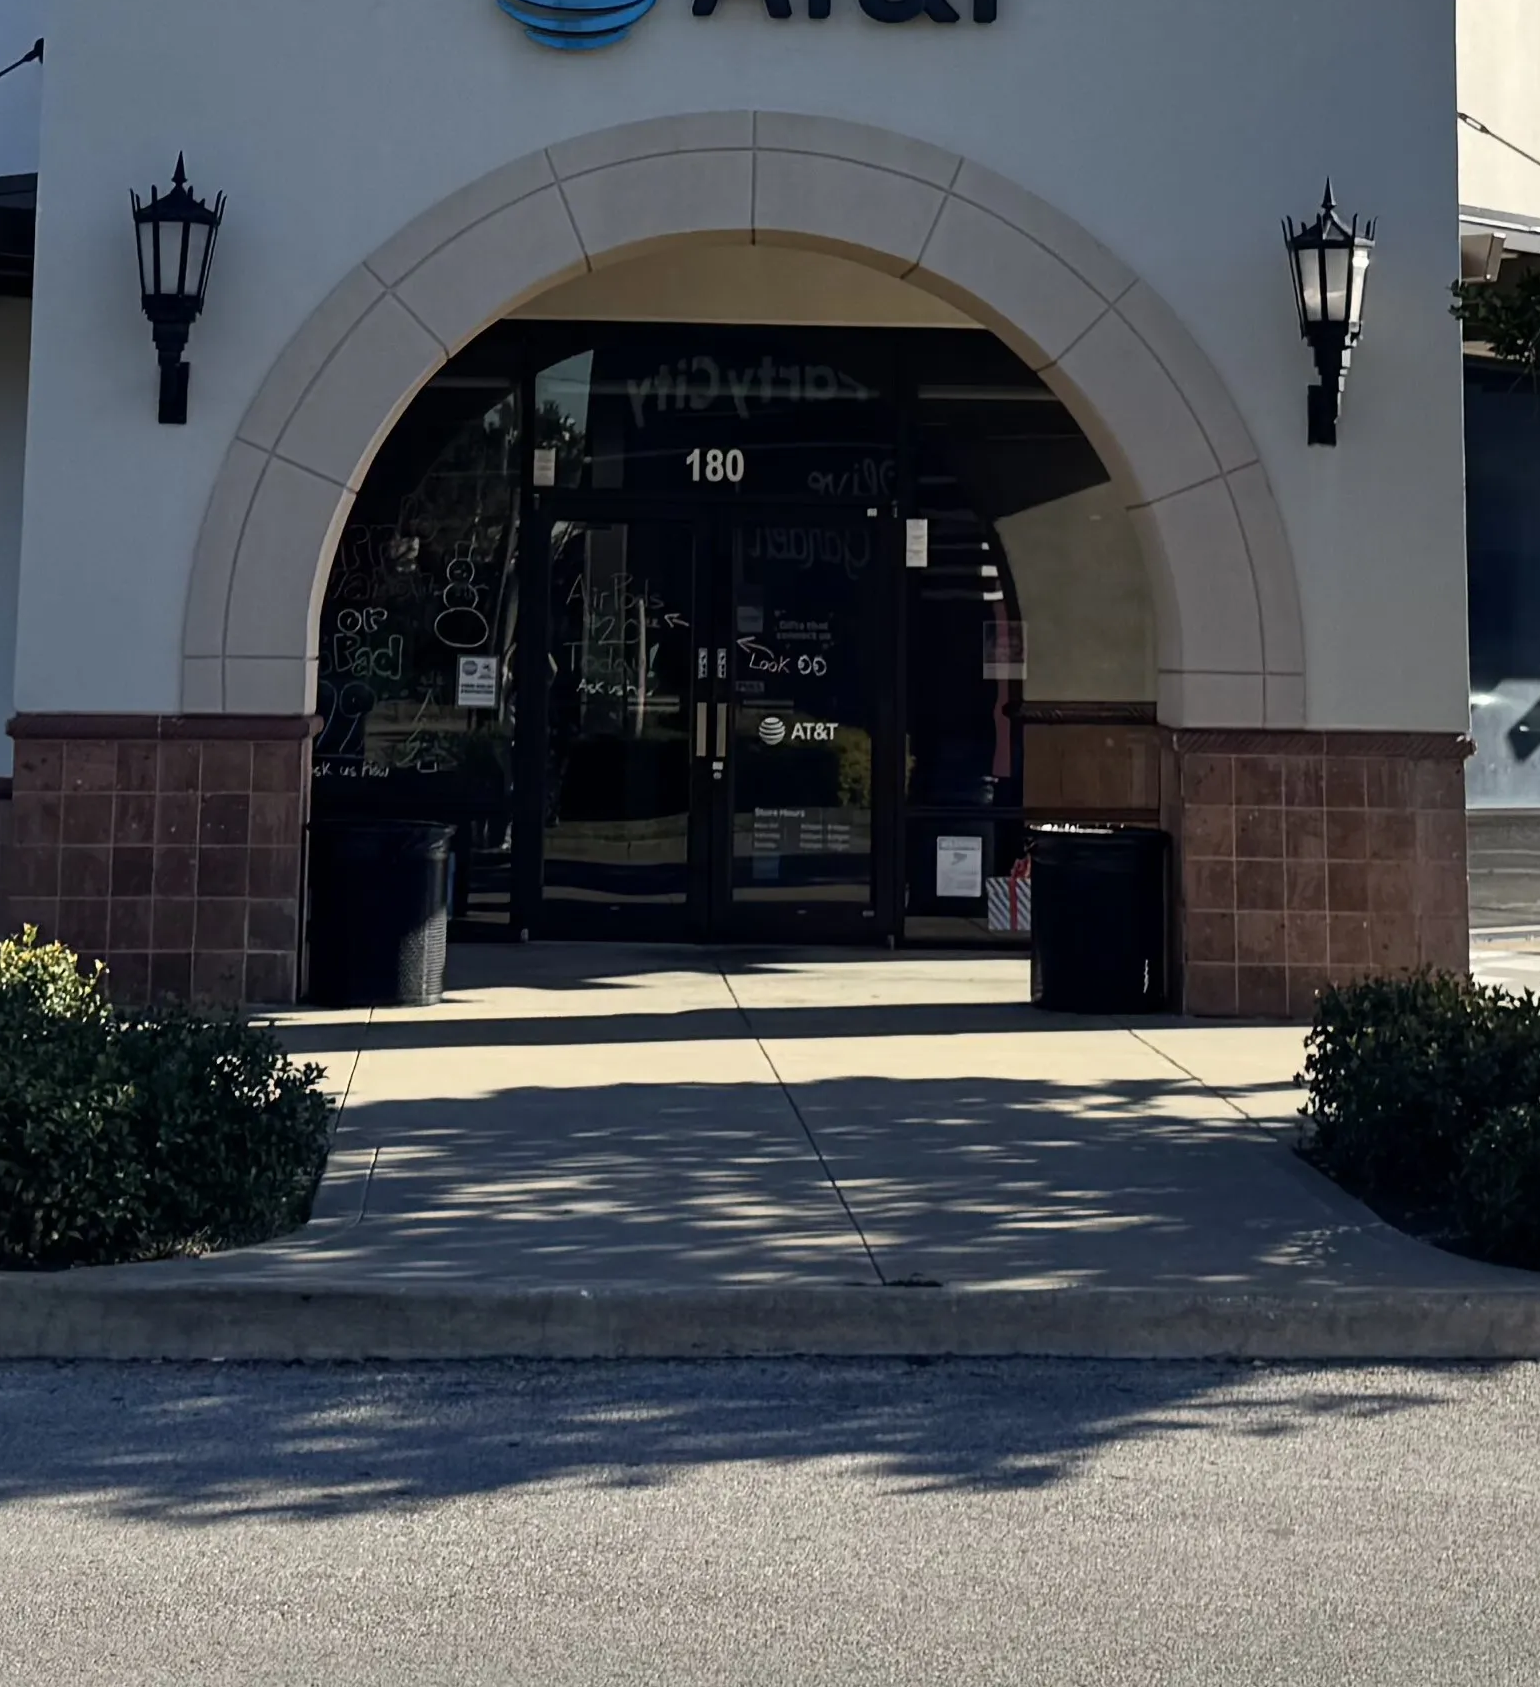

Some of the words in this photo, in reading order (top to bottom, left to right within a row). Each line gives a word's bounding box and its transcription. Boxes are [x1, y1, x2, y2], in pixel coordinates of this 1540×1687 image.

[685, 447, 745, 483] 180
[565, 571, 667, 612] AirPods
[749, 651, 791, 675] Look
[790, 722, 840, 741] AT&T
[314, 761, 333, 777] sk
